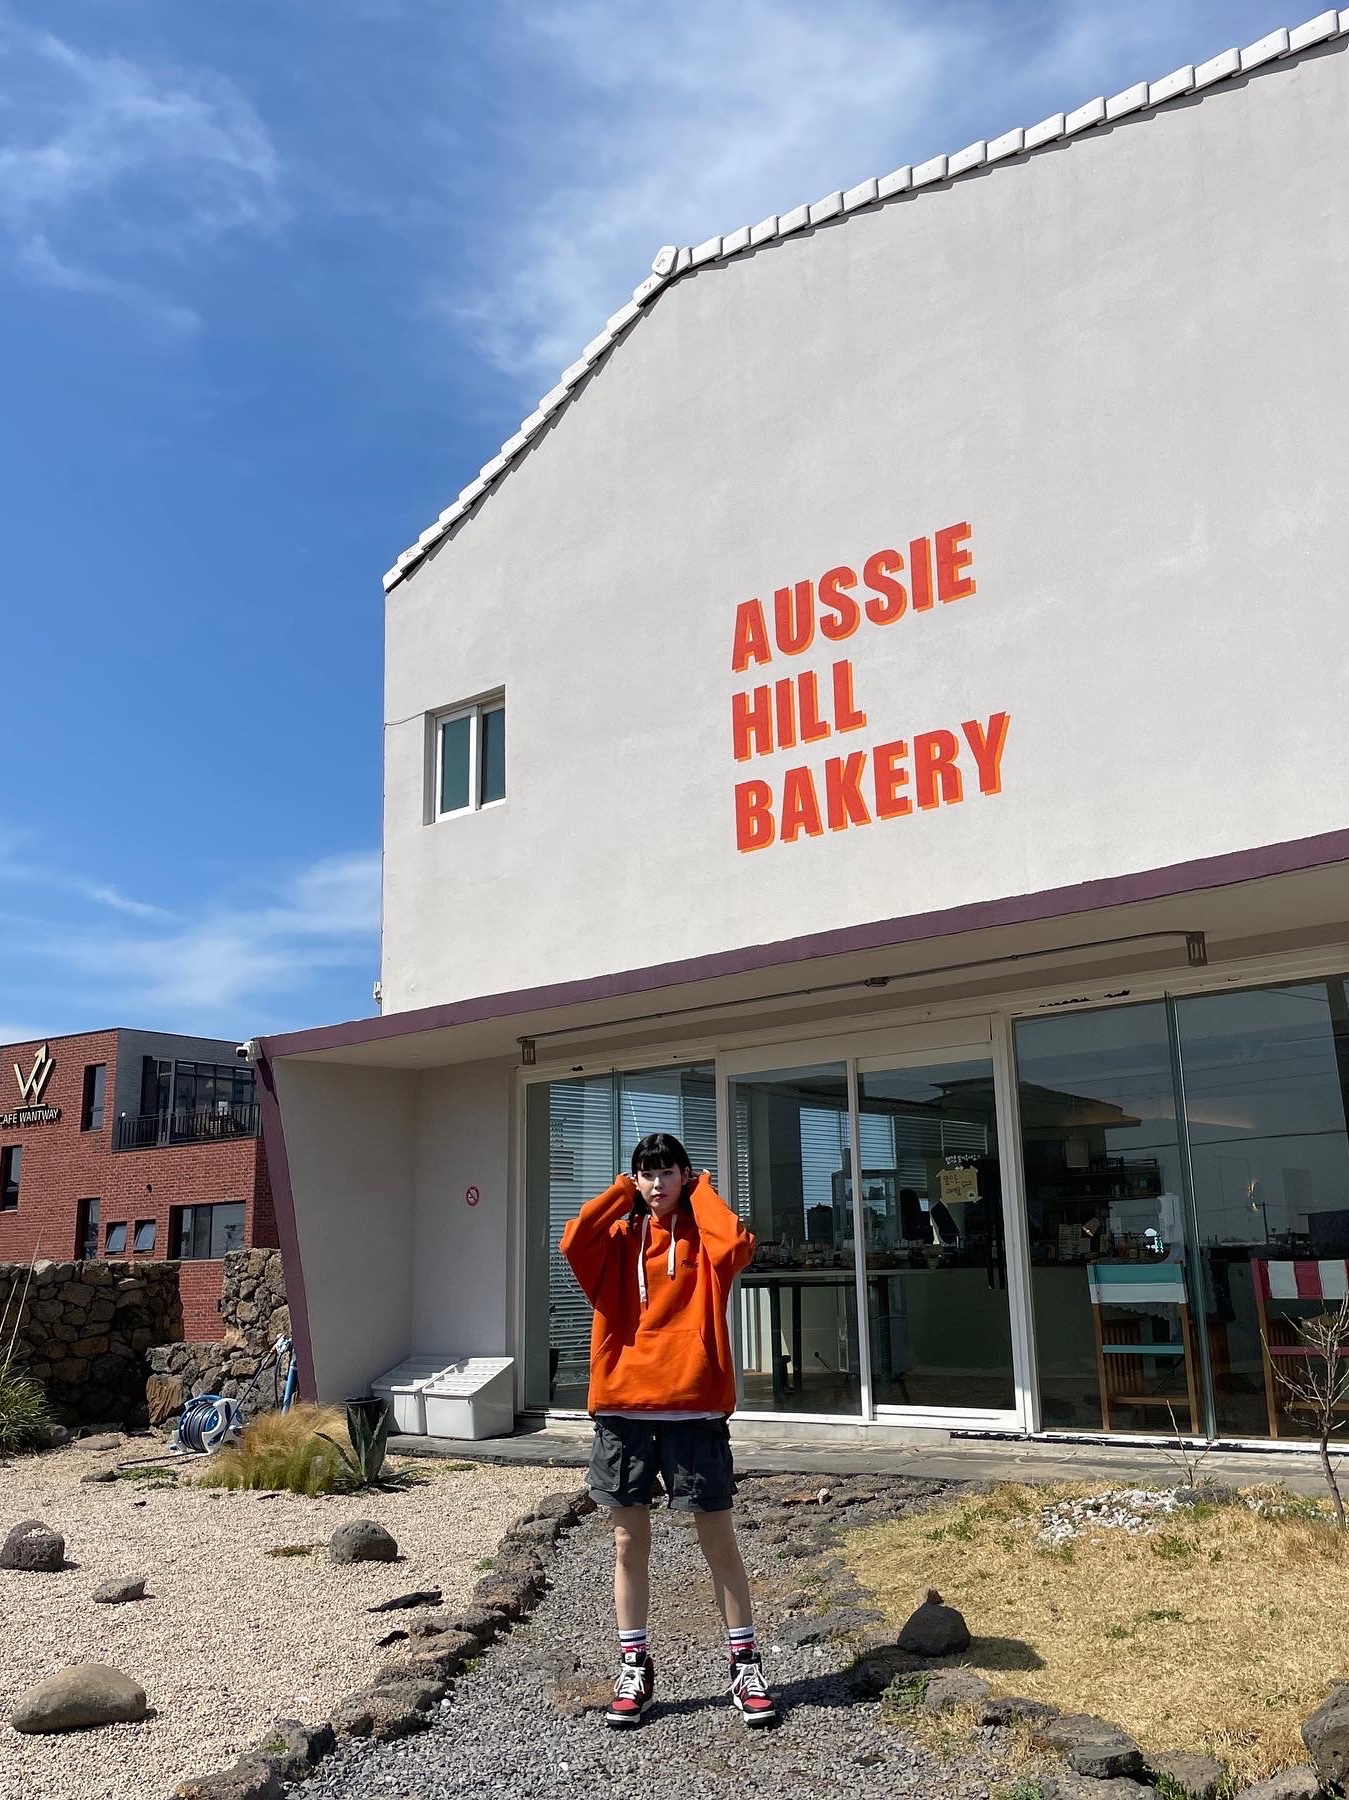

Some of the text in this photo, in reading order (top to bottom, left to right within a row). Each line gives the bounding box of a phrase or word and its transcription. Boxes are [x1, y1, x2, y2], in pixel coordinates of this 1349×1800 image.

[732, 522, 976, 672] AUSSIE
[732, 659, 867, 763] HILL
[734, 711, 1010, 853] BAKERY
[19, 1108, 59, 1122] WANTWAY
